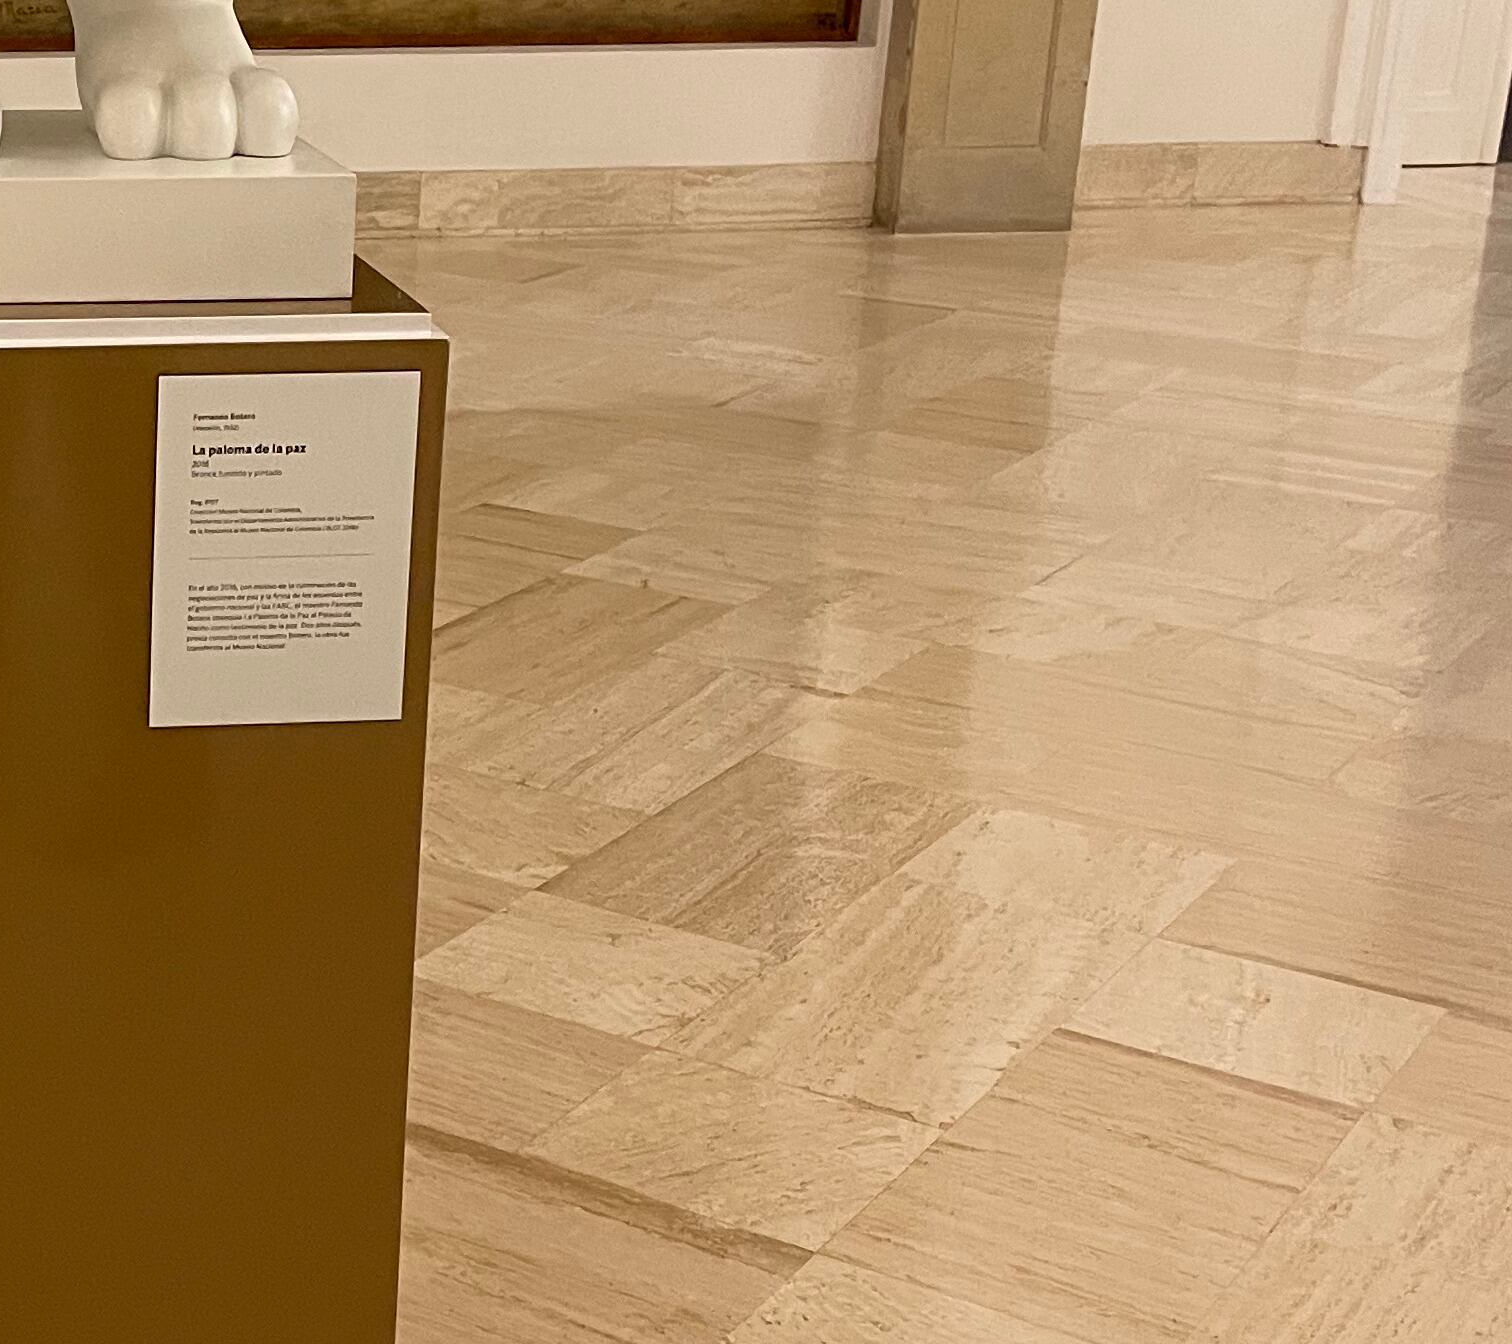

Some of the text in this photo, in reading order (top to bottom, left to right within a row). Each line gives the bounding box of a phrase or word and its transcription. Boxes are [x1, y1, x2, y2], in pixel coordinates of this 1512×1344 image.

[192, 443, 307, 457] La paloma de la paz
